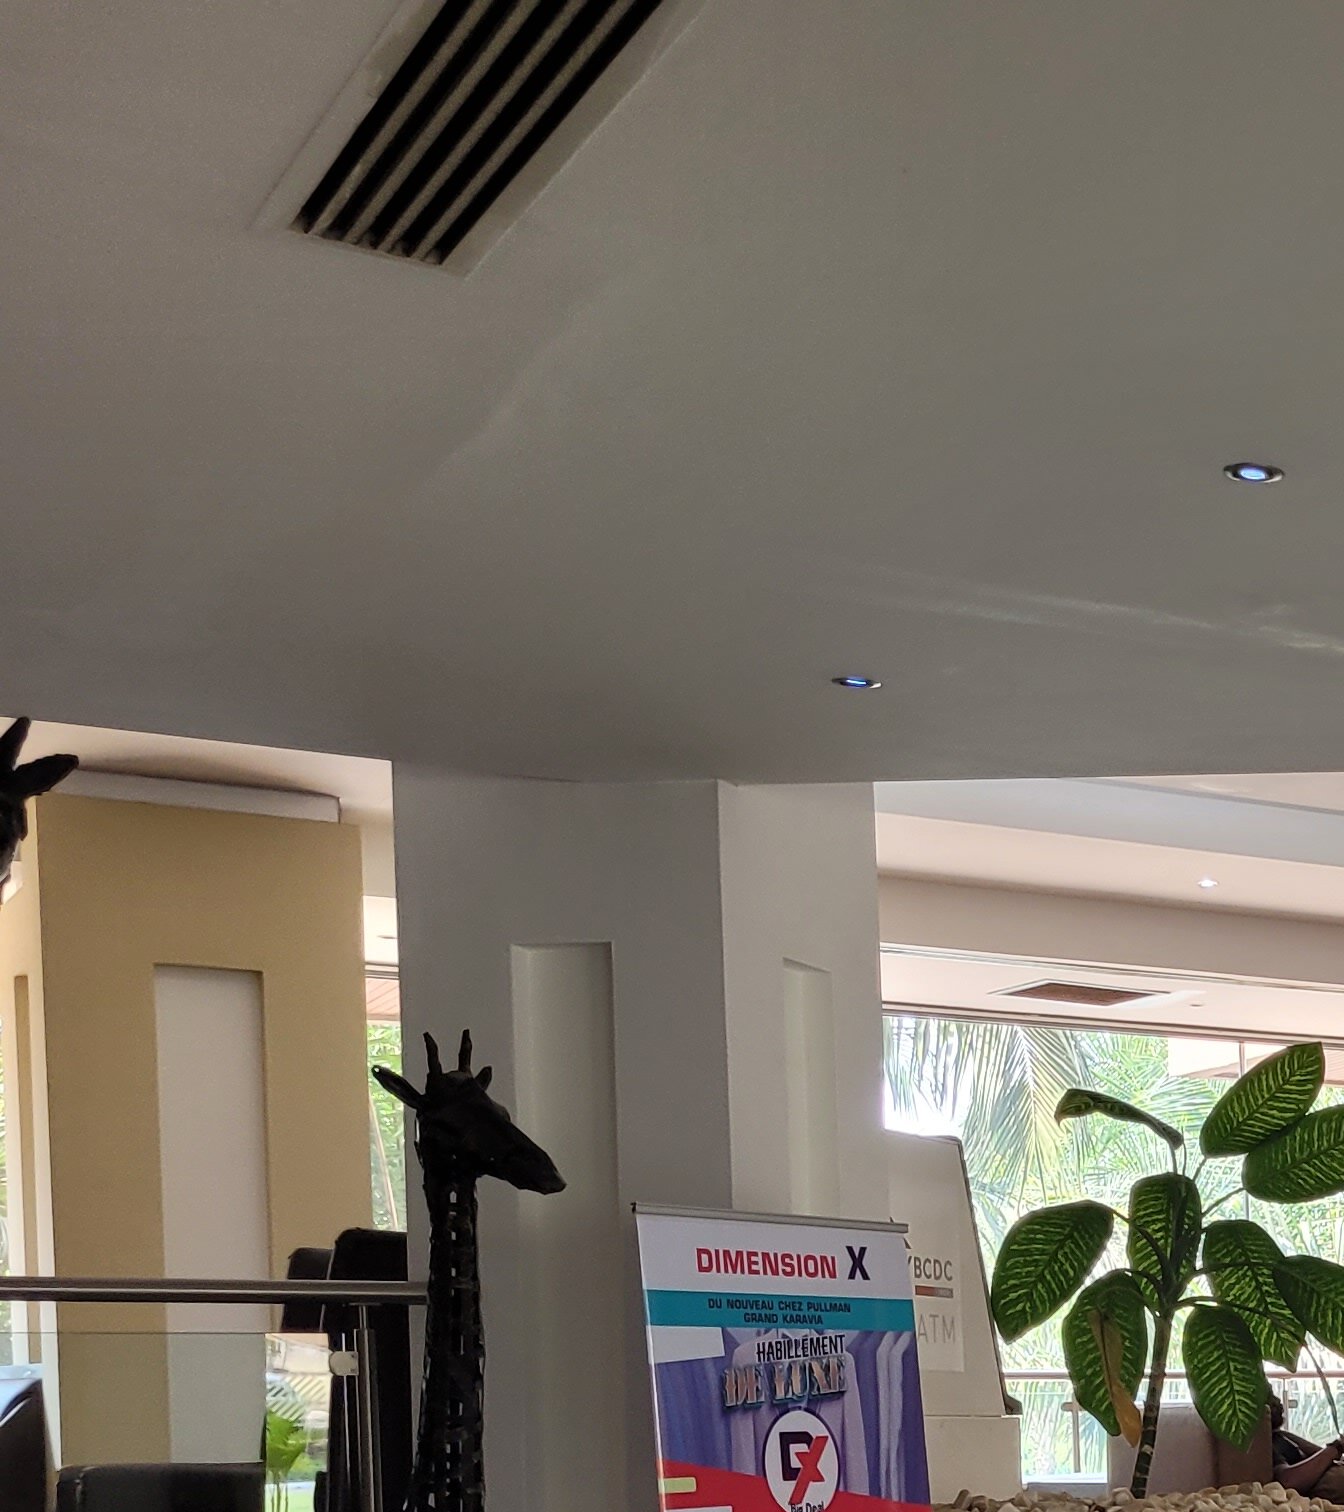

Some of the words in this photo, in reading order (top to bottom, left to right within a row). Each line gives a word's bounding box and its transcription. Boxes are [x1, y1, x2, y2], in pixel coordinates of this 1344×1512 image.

[696, 1248, 837, 1279] DIMENSION
[846, 1245, 871, 1280] X
[708, 1298, 722, 1309] DU
[726, 1299, 774, 1310] NOUVEAU
[778, 1301, 803, 1311] CHEZ
[807, 1302, 851, 1313] PULLMAN
[743, 1313, 779, 1324] GRAND
[783, 1314, 823, 1325] KARAVIA
[918, 1313, 955, 1343] ATM
[723, 1366, 765, 1408] DE
[772, 1357, 848, 1403] LUXE
